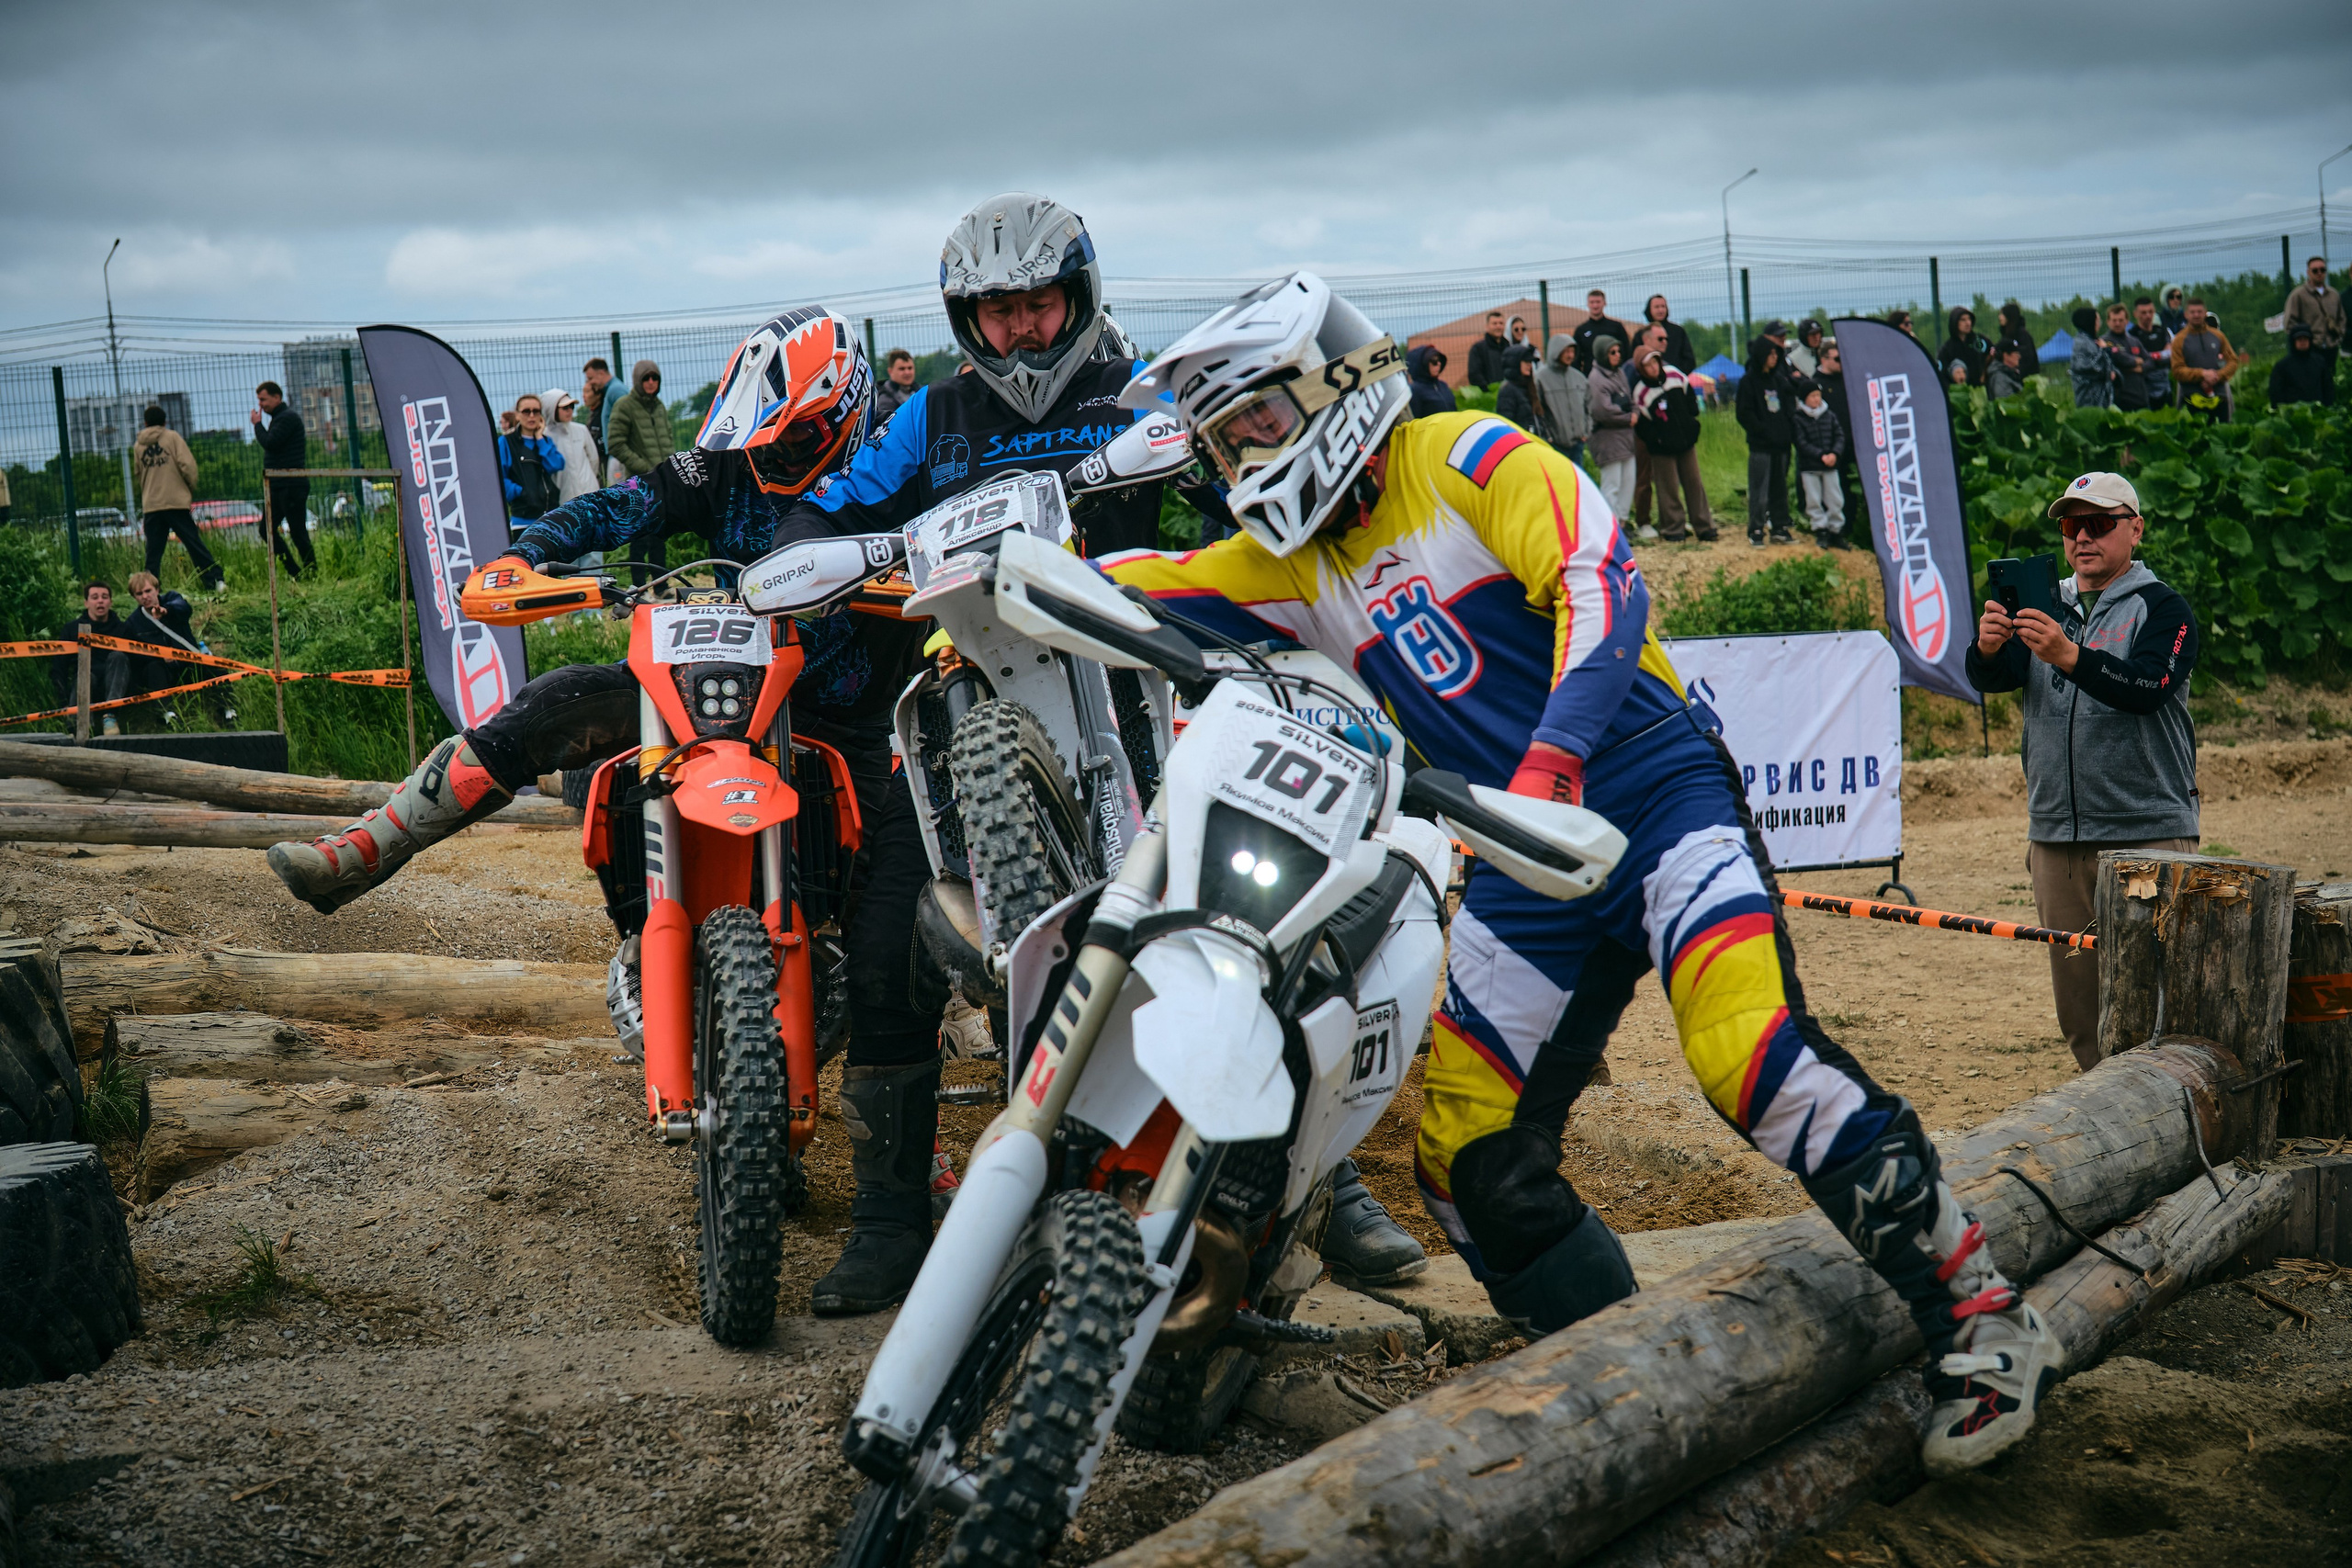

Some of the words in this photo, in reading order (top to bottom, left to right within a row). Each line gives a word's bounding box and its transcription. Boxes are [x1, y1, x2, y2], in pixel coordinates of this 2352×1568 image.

[939, 499, 1009, 541] 118
[947, 523, 1002, 547] Александр
[668, 618, 755, 648] 126
[1244, 739, 1350, 815] 101
[1840, 755, 1880, 795] ДВ
[1220, 783, 1275, 812] Якимов
[1278, 807, 1329, 845] Максим
[1349, 1029, 1389, 1084] 101
